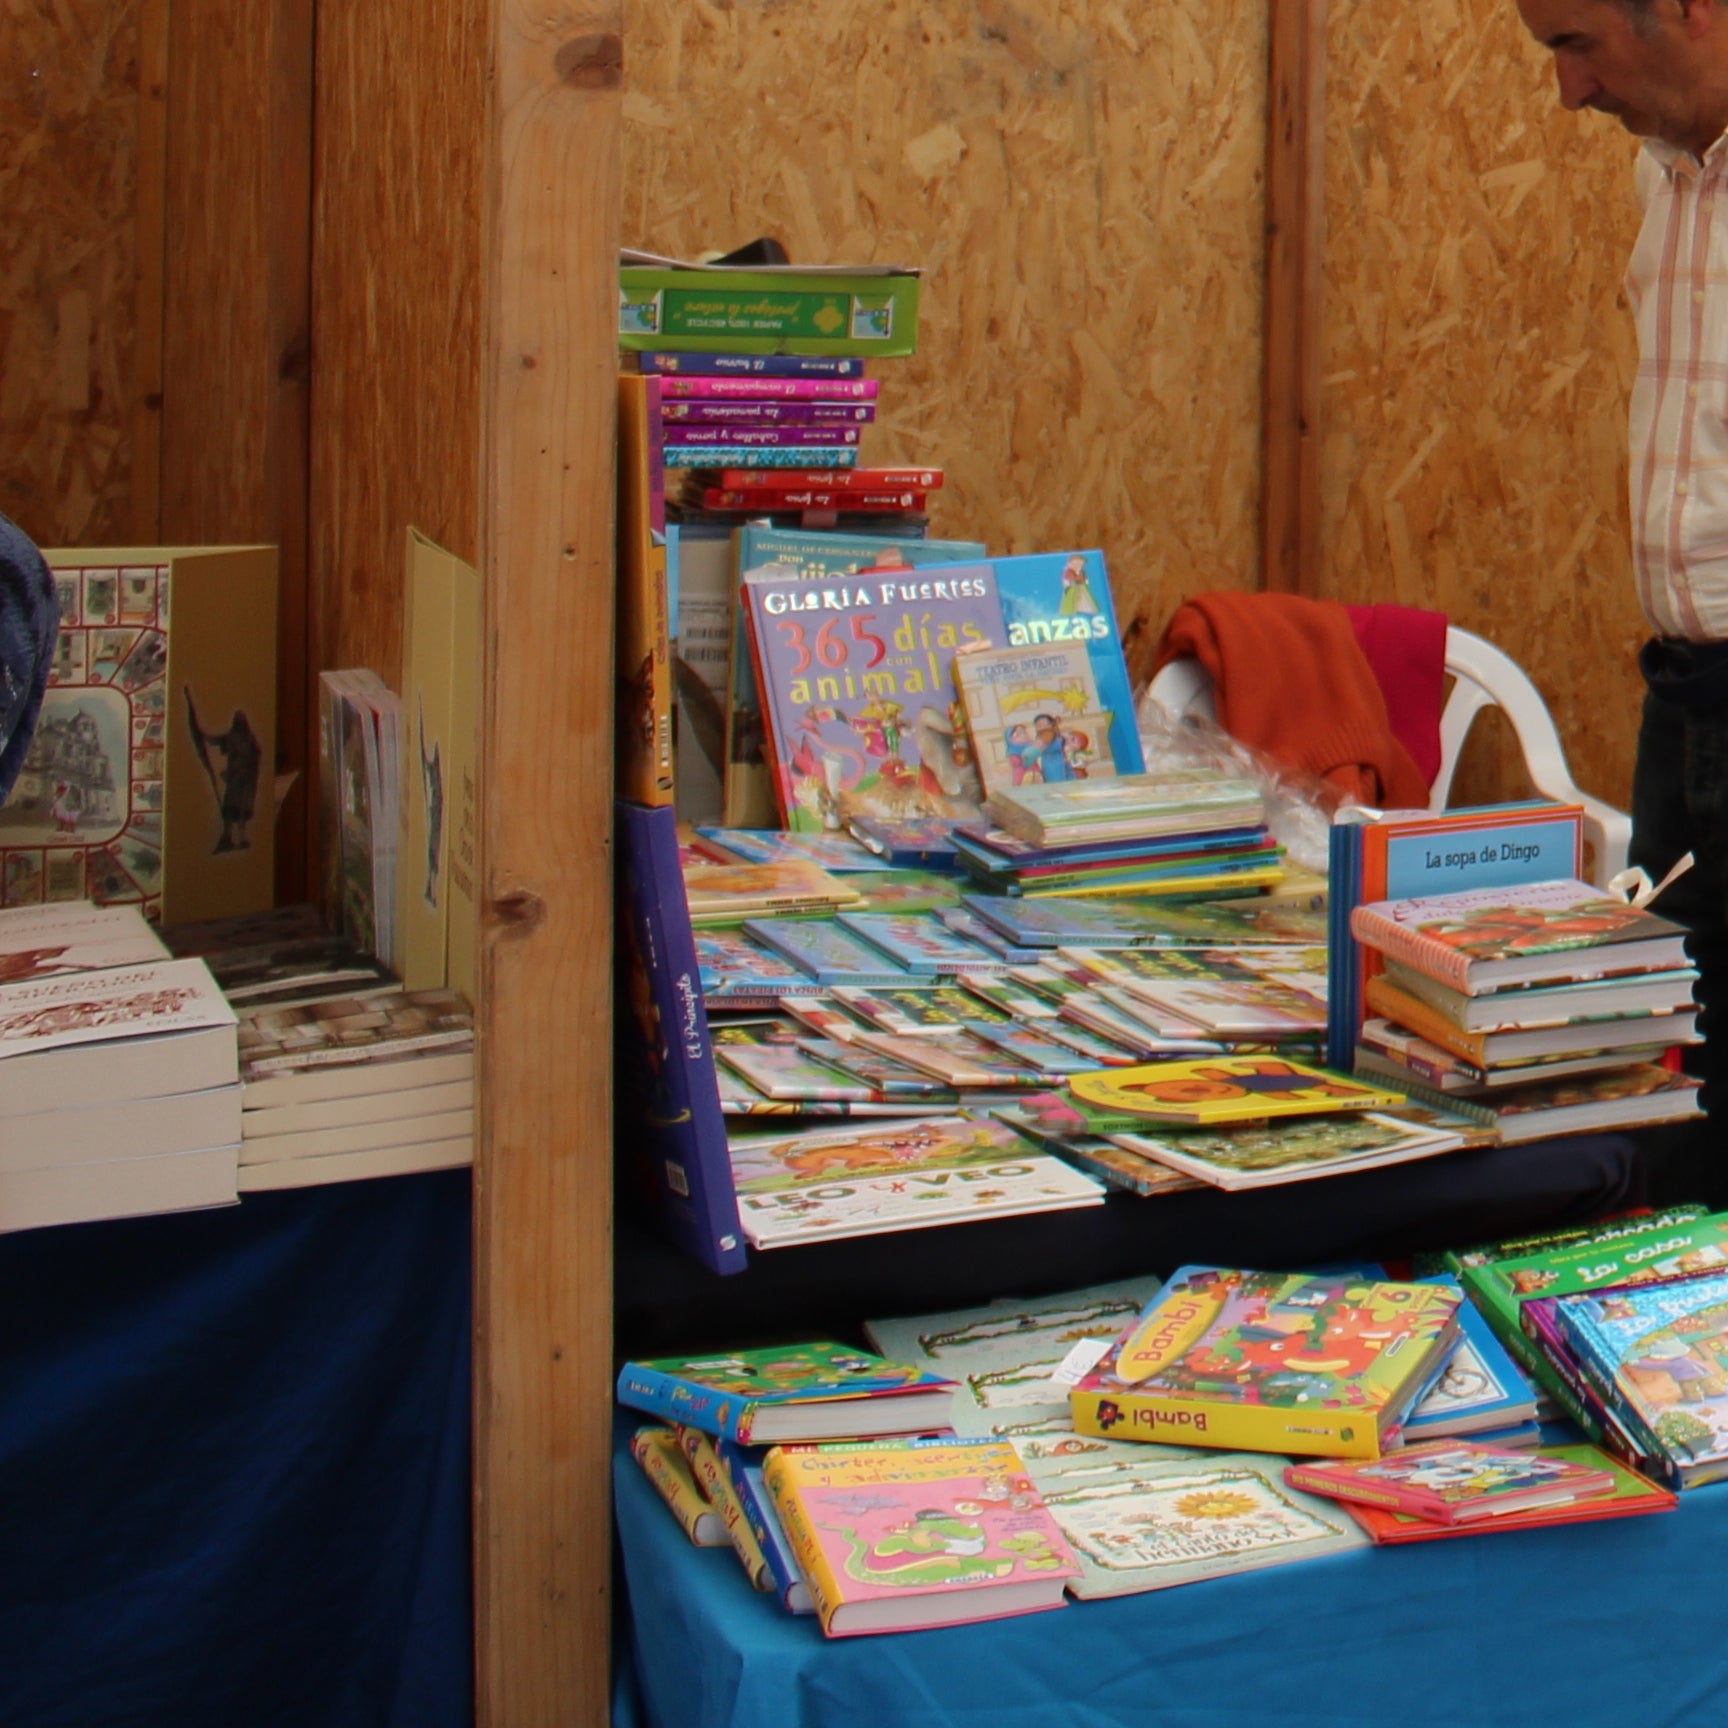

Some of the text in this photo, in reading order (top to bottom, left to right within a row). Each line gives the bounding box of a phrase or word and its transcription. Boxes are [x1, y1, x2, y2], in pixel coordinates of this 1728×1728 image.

[775, 613, 985, 677] 365 días
[1007, 613, 1110, 647] anzas
[788, 651, 943, 704] animal
[1425, 842, 1541, 870] La sopa de Dingo
[675, 971, 703, 1060] El Principito
[743, 1163, 1036, 1211] LEO VEO
[1133, 1300, 1204, 1362] Bambi
[1132, 1408, 1207, 1432] Bambi
